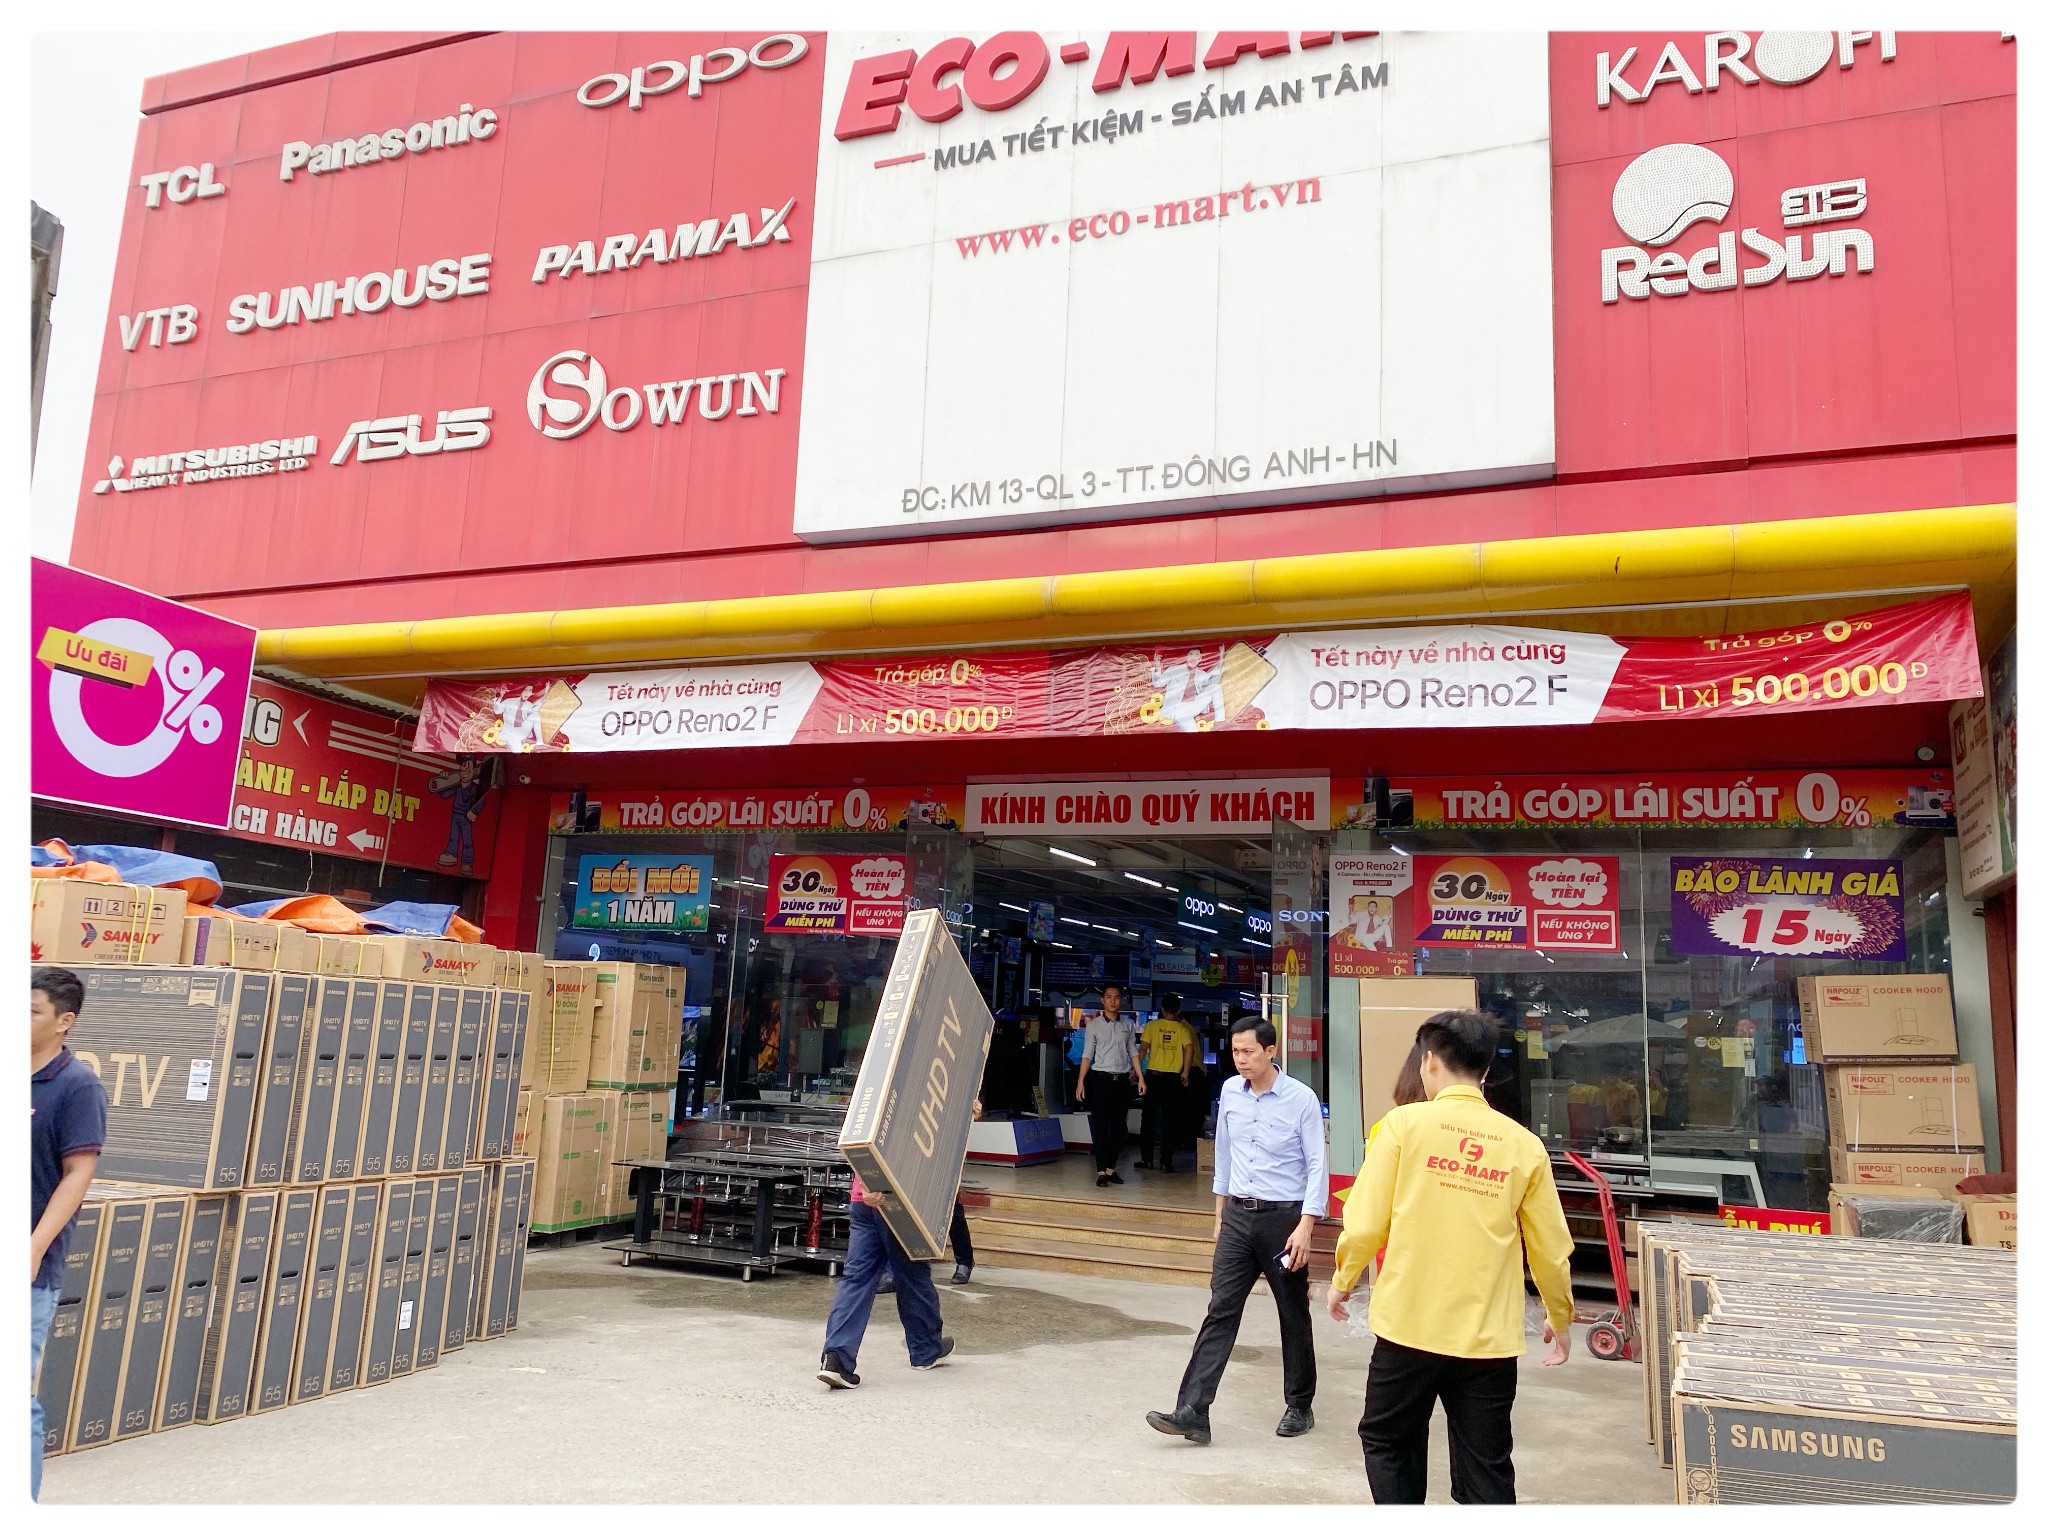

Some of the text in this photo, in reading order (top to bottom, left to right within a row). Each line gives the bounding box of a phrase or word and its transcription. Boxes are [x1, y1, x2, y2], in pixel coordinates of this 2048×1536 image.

[576, 33, 809, 110] oppo
[933, 62, 1389, 171] MUA TIẾT KIỆM SẮM AN TÂM
[280, 103, 498, 182] Panasonic
[139, 161, 226, 209] TCL
[531, 196, 798, 284] PARAMAX
[225, 252, 493, 335] SUNHOUSE
[118, 303, 199, 352] VTB
[330, 406, 493, 466] ASUS
[130, 435, 318, 476] MITSUBISHI
[279, 457, 309, 472] LTD
[951, 481, 990, 508] KM
[1081, 471, 1096, 496] 3
[1162, 454, 1250, 489] ĐÔNG
[1704, 620, 1873, 650] Trả góp 0%
[65, 639, 128, 672] Ưu đãi
[1311, 640, 1566, 669] Tết này về nhà cùng
[874, 659, 983, 687] Trả góp 0%
[608, 678, 782, 702] Tết này về nhà cùng
[1310, 674, 1568, 710] OPPO Reno2 F
[1660, 684, 1684, 710] Lì
[1693, 684, 1718, 708] xì
[601, 705, 778, 736] OPPO Reno2 F
[837, 714, 853, 734] Lì
[859, 714, 877, 733] xì
[317, 769, 366, 810] LẮP
[372, 788, 420, 824] ĐẶT
[620, 788, 888, 831] TRẢ GÓP LÃI SUẤT 0%
[981, 787, 1315, 826] KÍNH CHÀO QUÝ KHÁCH
[1443, 772, 1871, 827] TRẢ GÓP LÃI SUẤT 0%
[274, 809, 338, 847] HÀNG
[591, 859, 700, 894] ĐỔI MỚI
[855, 868, 884, 878] Hoàn
[1335, 861, 1407, 870] OPPO Reno2 F
[1535, 872, 1601, 885] Hoàn lại
[1675, 862, 1899, 896] BẢO LÃNH GIÁ
[782, 871, 836, 894] 30 Ngày
[865, 880, 890, 891] TIỀN
[1434, 874, 1509, 902] 30 Ngày
[1551, 885, 1585, 898] TIỀN
[112, 902, 119, 911] 2
[607, 896, 675, 923] 1 NĂM
[780, 899, 843, 911] DÙNG THỬ
[856, 908, 903, 917] NẾU KHÔNG
[1185, 897, 1215, 916] oppo
[1433, 908, 1522, 922] DÙNG THỬ
[785, 913, 836, 927] MIỄN PHÍ
[1248, 916, 1271, 933] oppo
[1442, 925, 1513, 941] MIỄN PHÍ
[1541, 920, 1609, 929] NẾU KHÔNG
[1742, 909, 1852, 945] 15 Ngày
[102, 930, 160, 944] SANAKY
[1557, 930, 1594, 939] ƯNG Ý
[434, 958, 478, 972] SANAKY
[913, 997, 962, 1158] UHD TV
[852, 1086, 874, 1136] SAMSUNG
[878, 1088, 899, 1147] SAMSUNG
[220, 1168, 236, 1182] 55
[261, 1163, 276, 1177] 55
[1427, 1156, 1510, 1183] ECO-MART
[1439, 1181, 1499, 1199] www.eco-mart.vn
[1730, 1423, 1886, 1462] SAMSUNG
